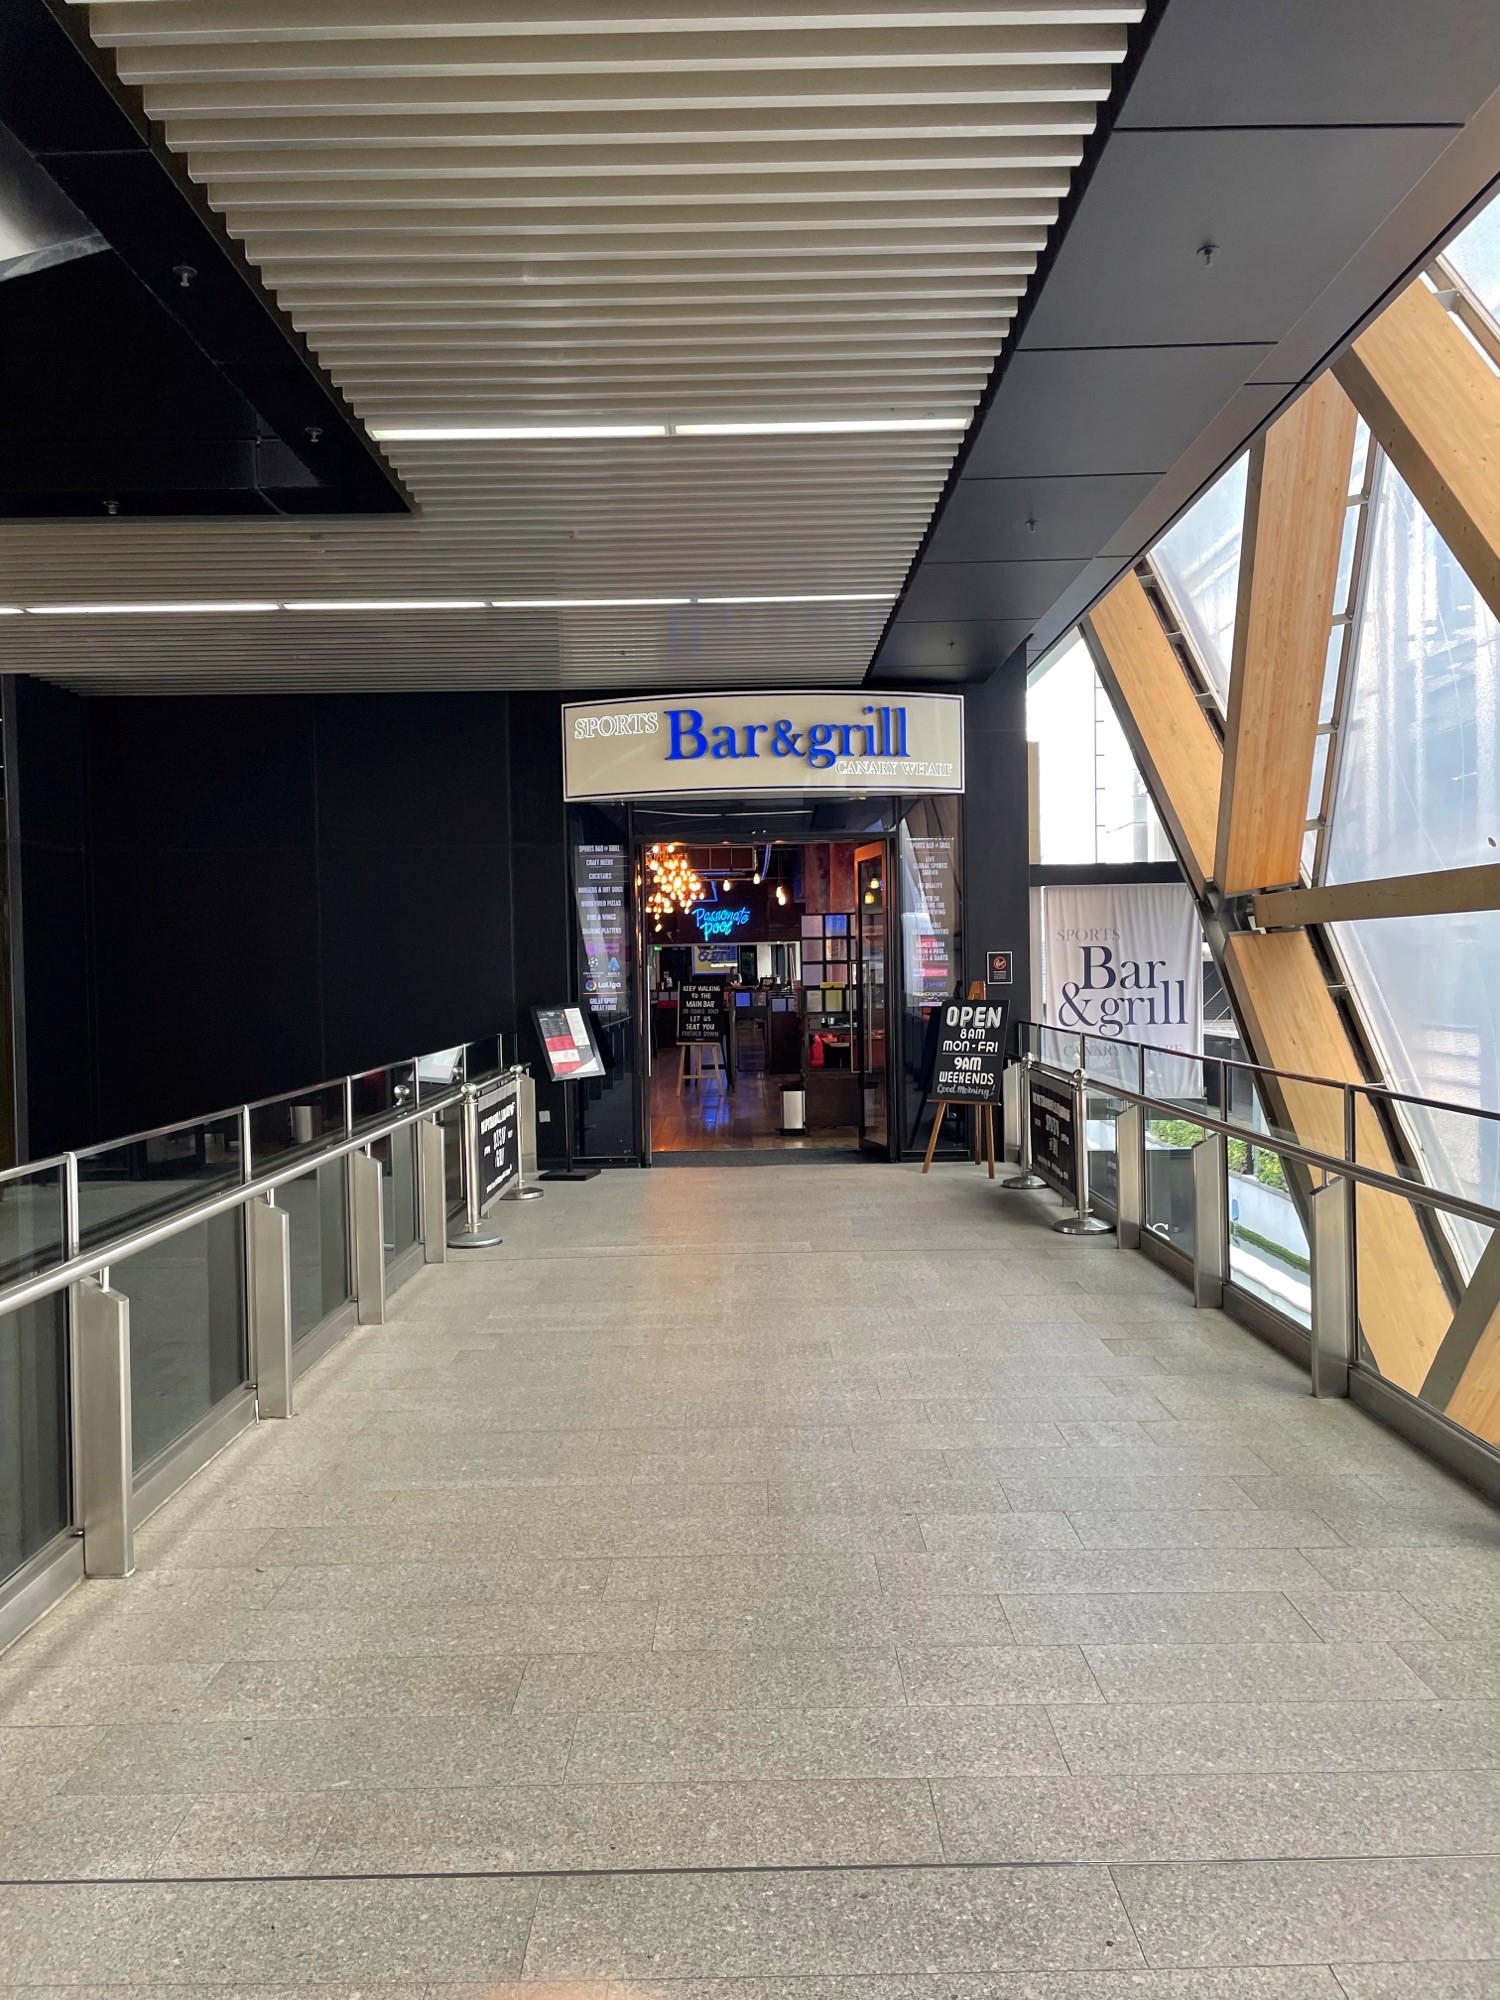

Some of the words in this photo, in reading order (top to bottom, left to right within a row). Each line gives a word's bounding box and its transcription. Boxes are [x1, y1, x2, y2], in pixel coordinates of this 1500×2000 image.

[575, 712, 659, 739] SPORTS
[835, 760, 899, 775] CANARY
[900, 761, 953, 777] WHARF
[692, 907, 750, 926] Passionate
[1057, 928, 1120, 941] SPORTS
[1078, 945, 1166, 990] Bar
[597, 981, 621, 989] LaLiga
[946, 1006, 1002, 1028] OPEN
[960, 1028, 985, 1040] 8AM
[954, 1056, 982, 1071] 9AM
[939, 1071, 995, 1085] WEEKENDS
